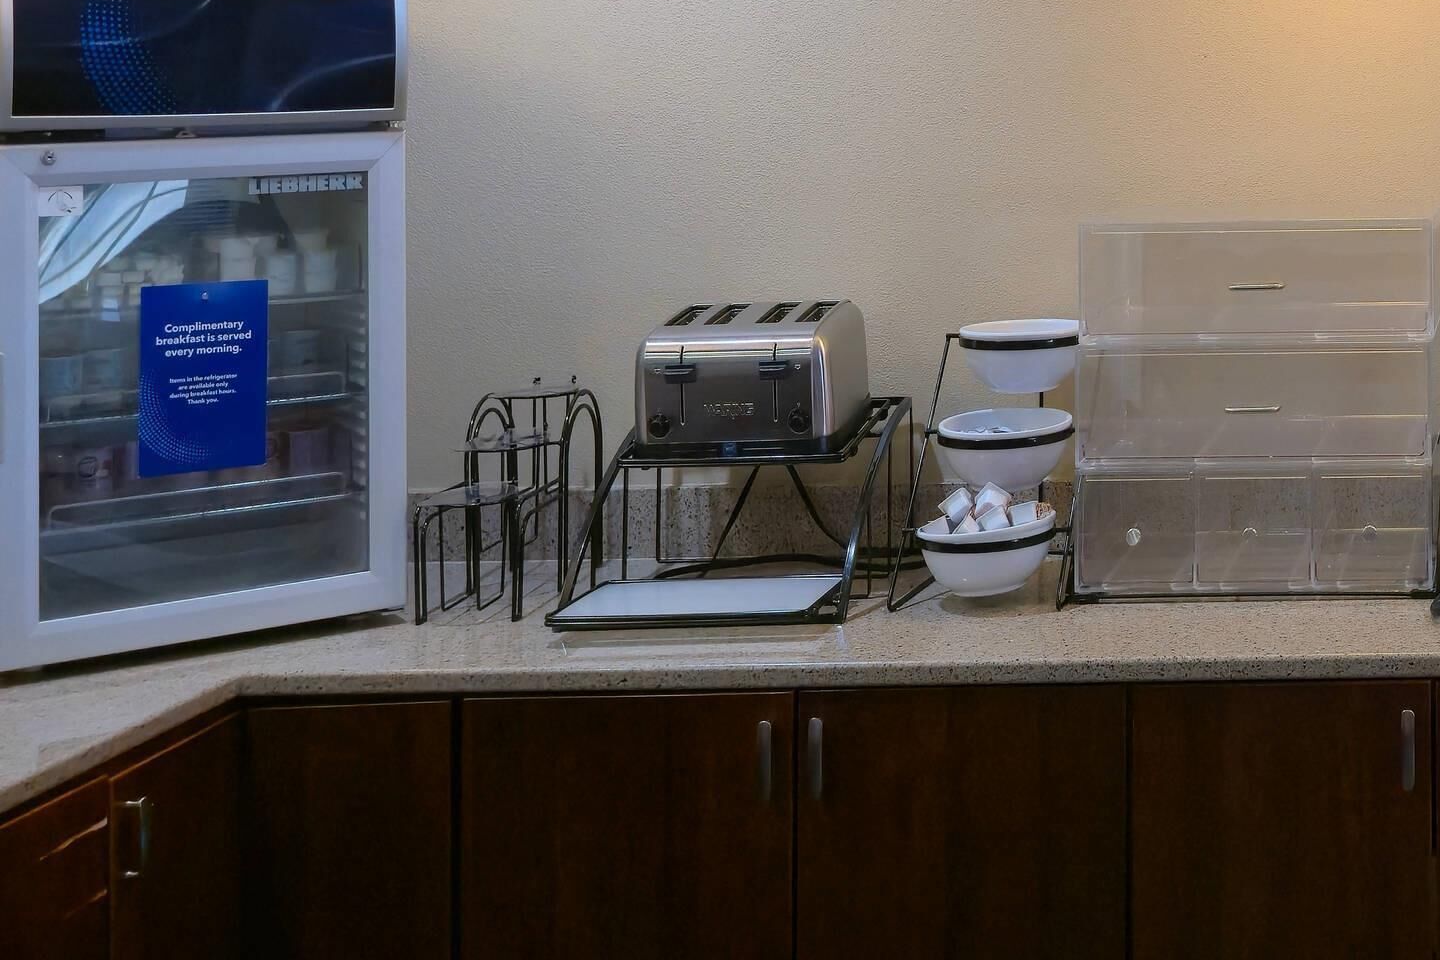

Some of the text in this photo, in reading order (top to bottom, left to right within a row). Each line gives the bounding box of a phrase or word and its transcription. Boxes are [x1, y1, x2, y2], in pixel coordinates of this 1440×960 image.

[248, 173, 364, 195] LIEBHERR
[164, 320, 244, 334] Complimentary
[155, 329, 252, 346] breakfast is served
[164, 343, 243, 357] every morning.
[203, 373, 238, 381] refrigerator
[189, 381, 215, 390] available
[190, 389, 218, 397] breakfast
